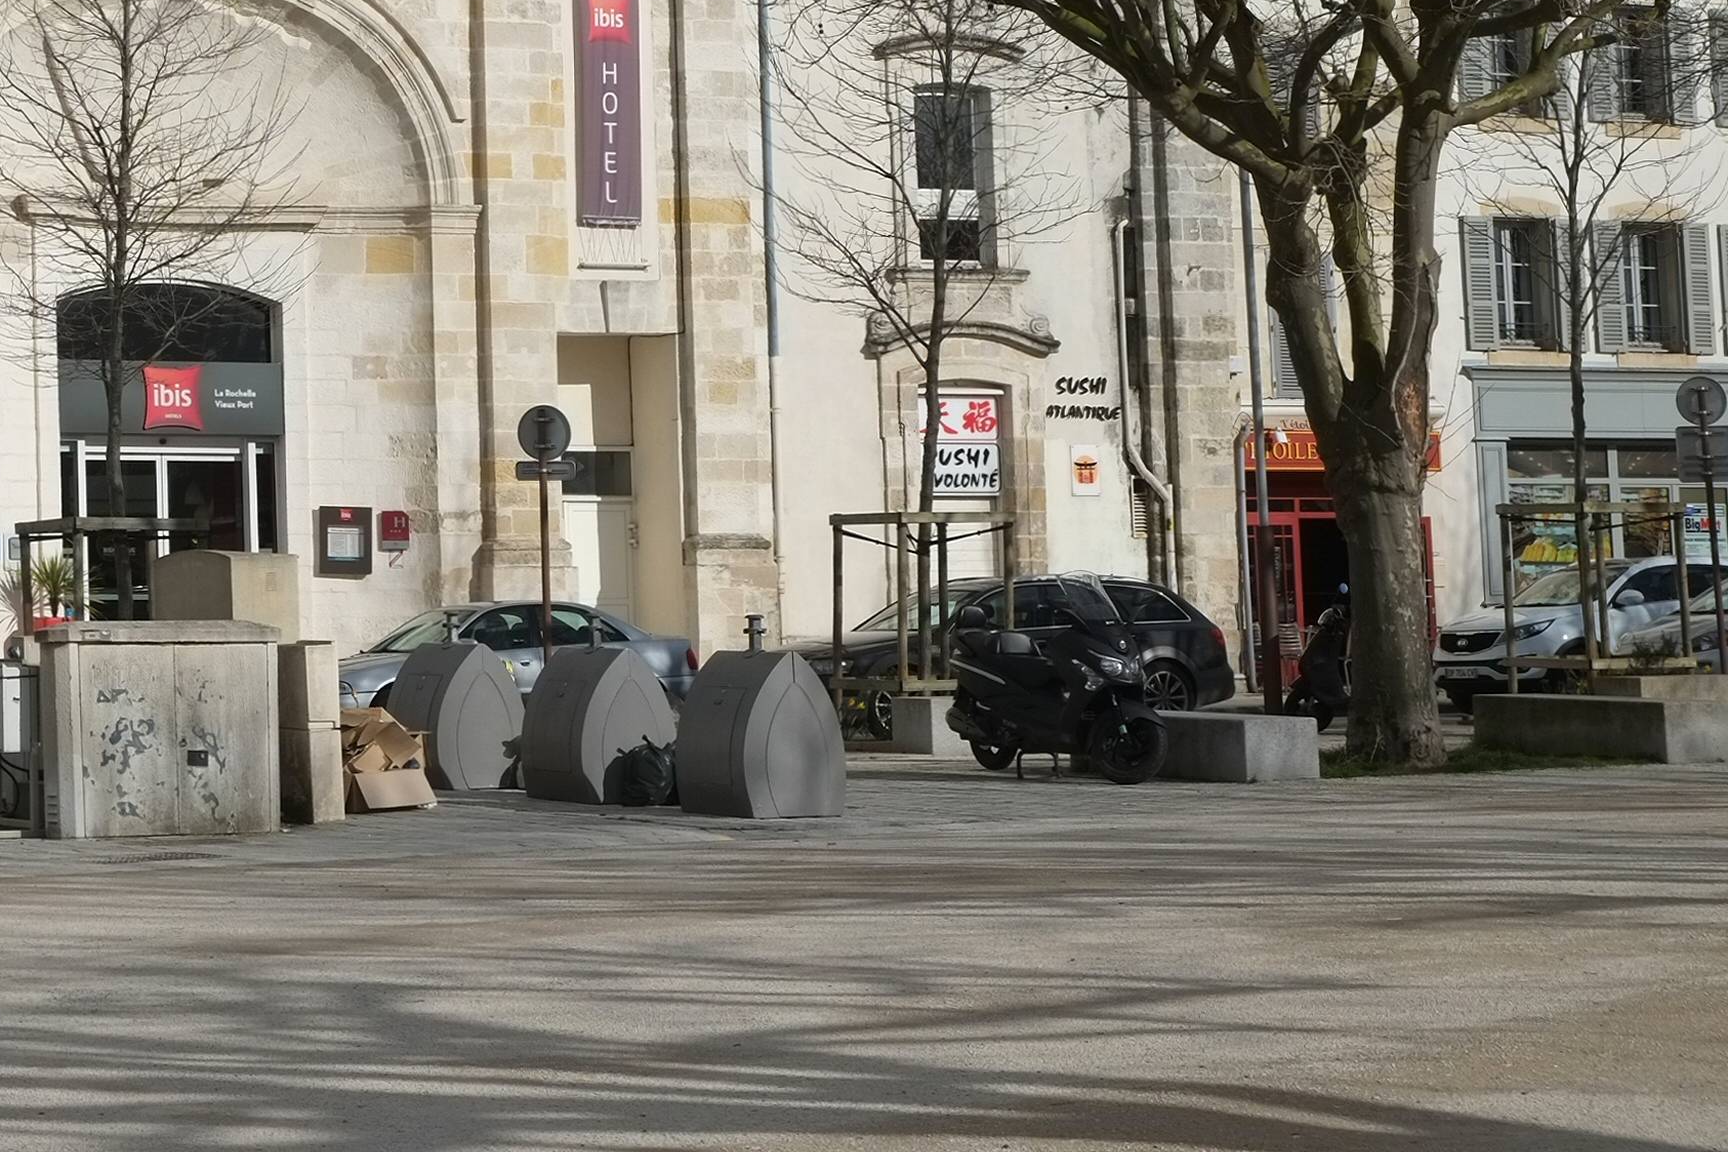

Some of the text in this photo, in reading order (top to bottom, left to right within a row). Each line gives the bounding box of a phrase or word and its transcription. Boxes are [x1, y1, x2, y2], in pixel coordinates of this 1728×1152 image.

[594, 8, 624, 28] ibis
[601, 62, 619, 203] HOTEL
[153, 384, 192, 407] ibis
[214, 389, 223, 397] La
[1055, 377, 1107, 396] SUSHI
[1046, 404, 1123, 421] ATLANTIQUE
[938, 447, 990, 469] USHI
[933, 468, 999, 488] VOLONTÉ
[393, 516, 406, 528] H
